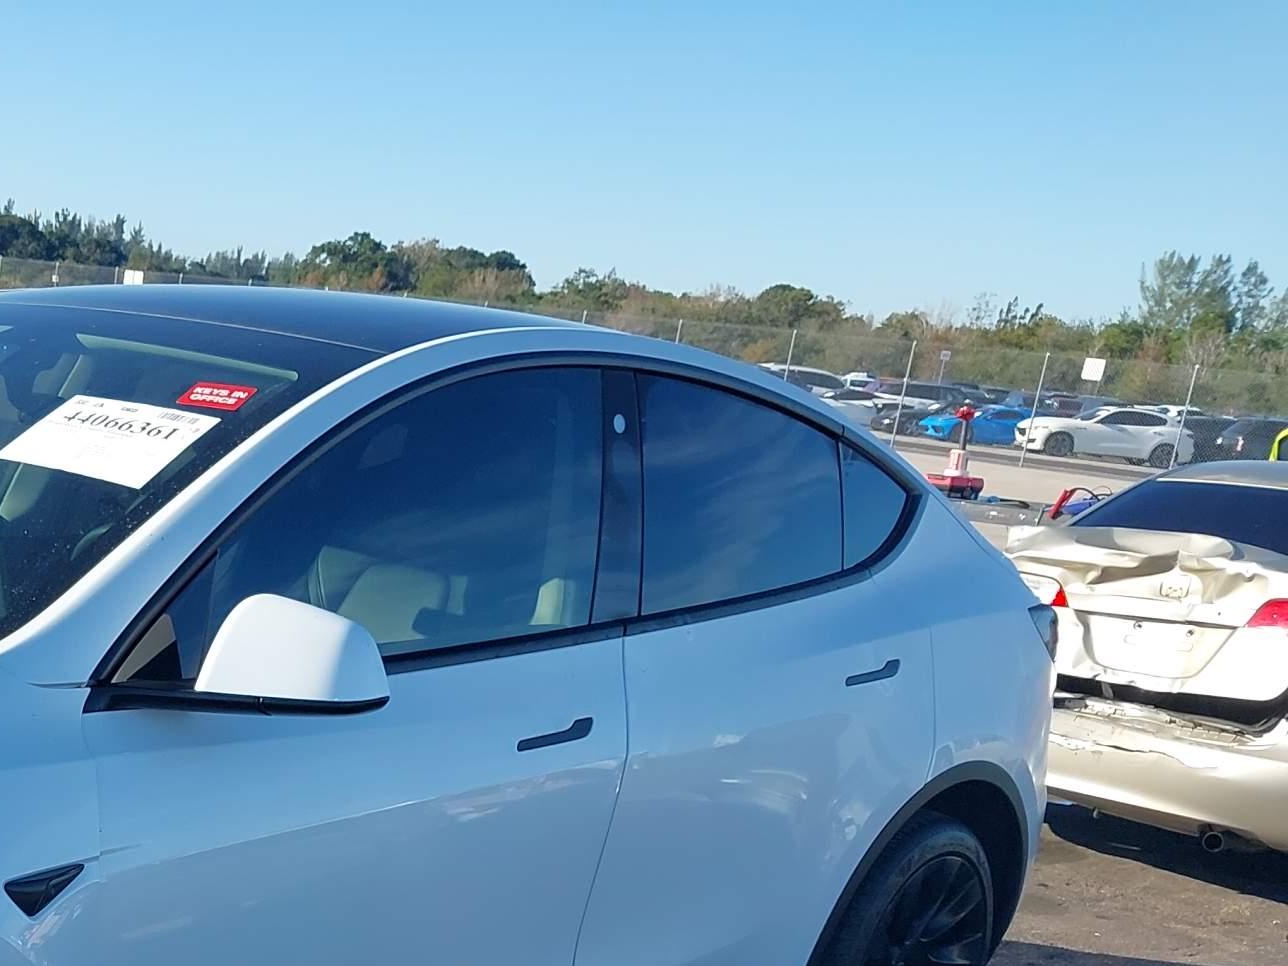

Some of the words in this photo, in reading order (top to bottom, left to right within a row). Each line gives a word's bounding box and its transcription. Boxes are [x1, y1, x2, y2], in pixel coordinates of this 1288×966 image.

[189, 393, 239, 405] OFFICE
[193, 386, 230, 396] KEYS
[230, 390, 249, 399] IN
[63, 410, 179, 440] 44066361
